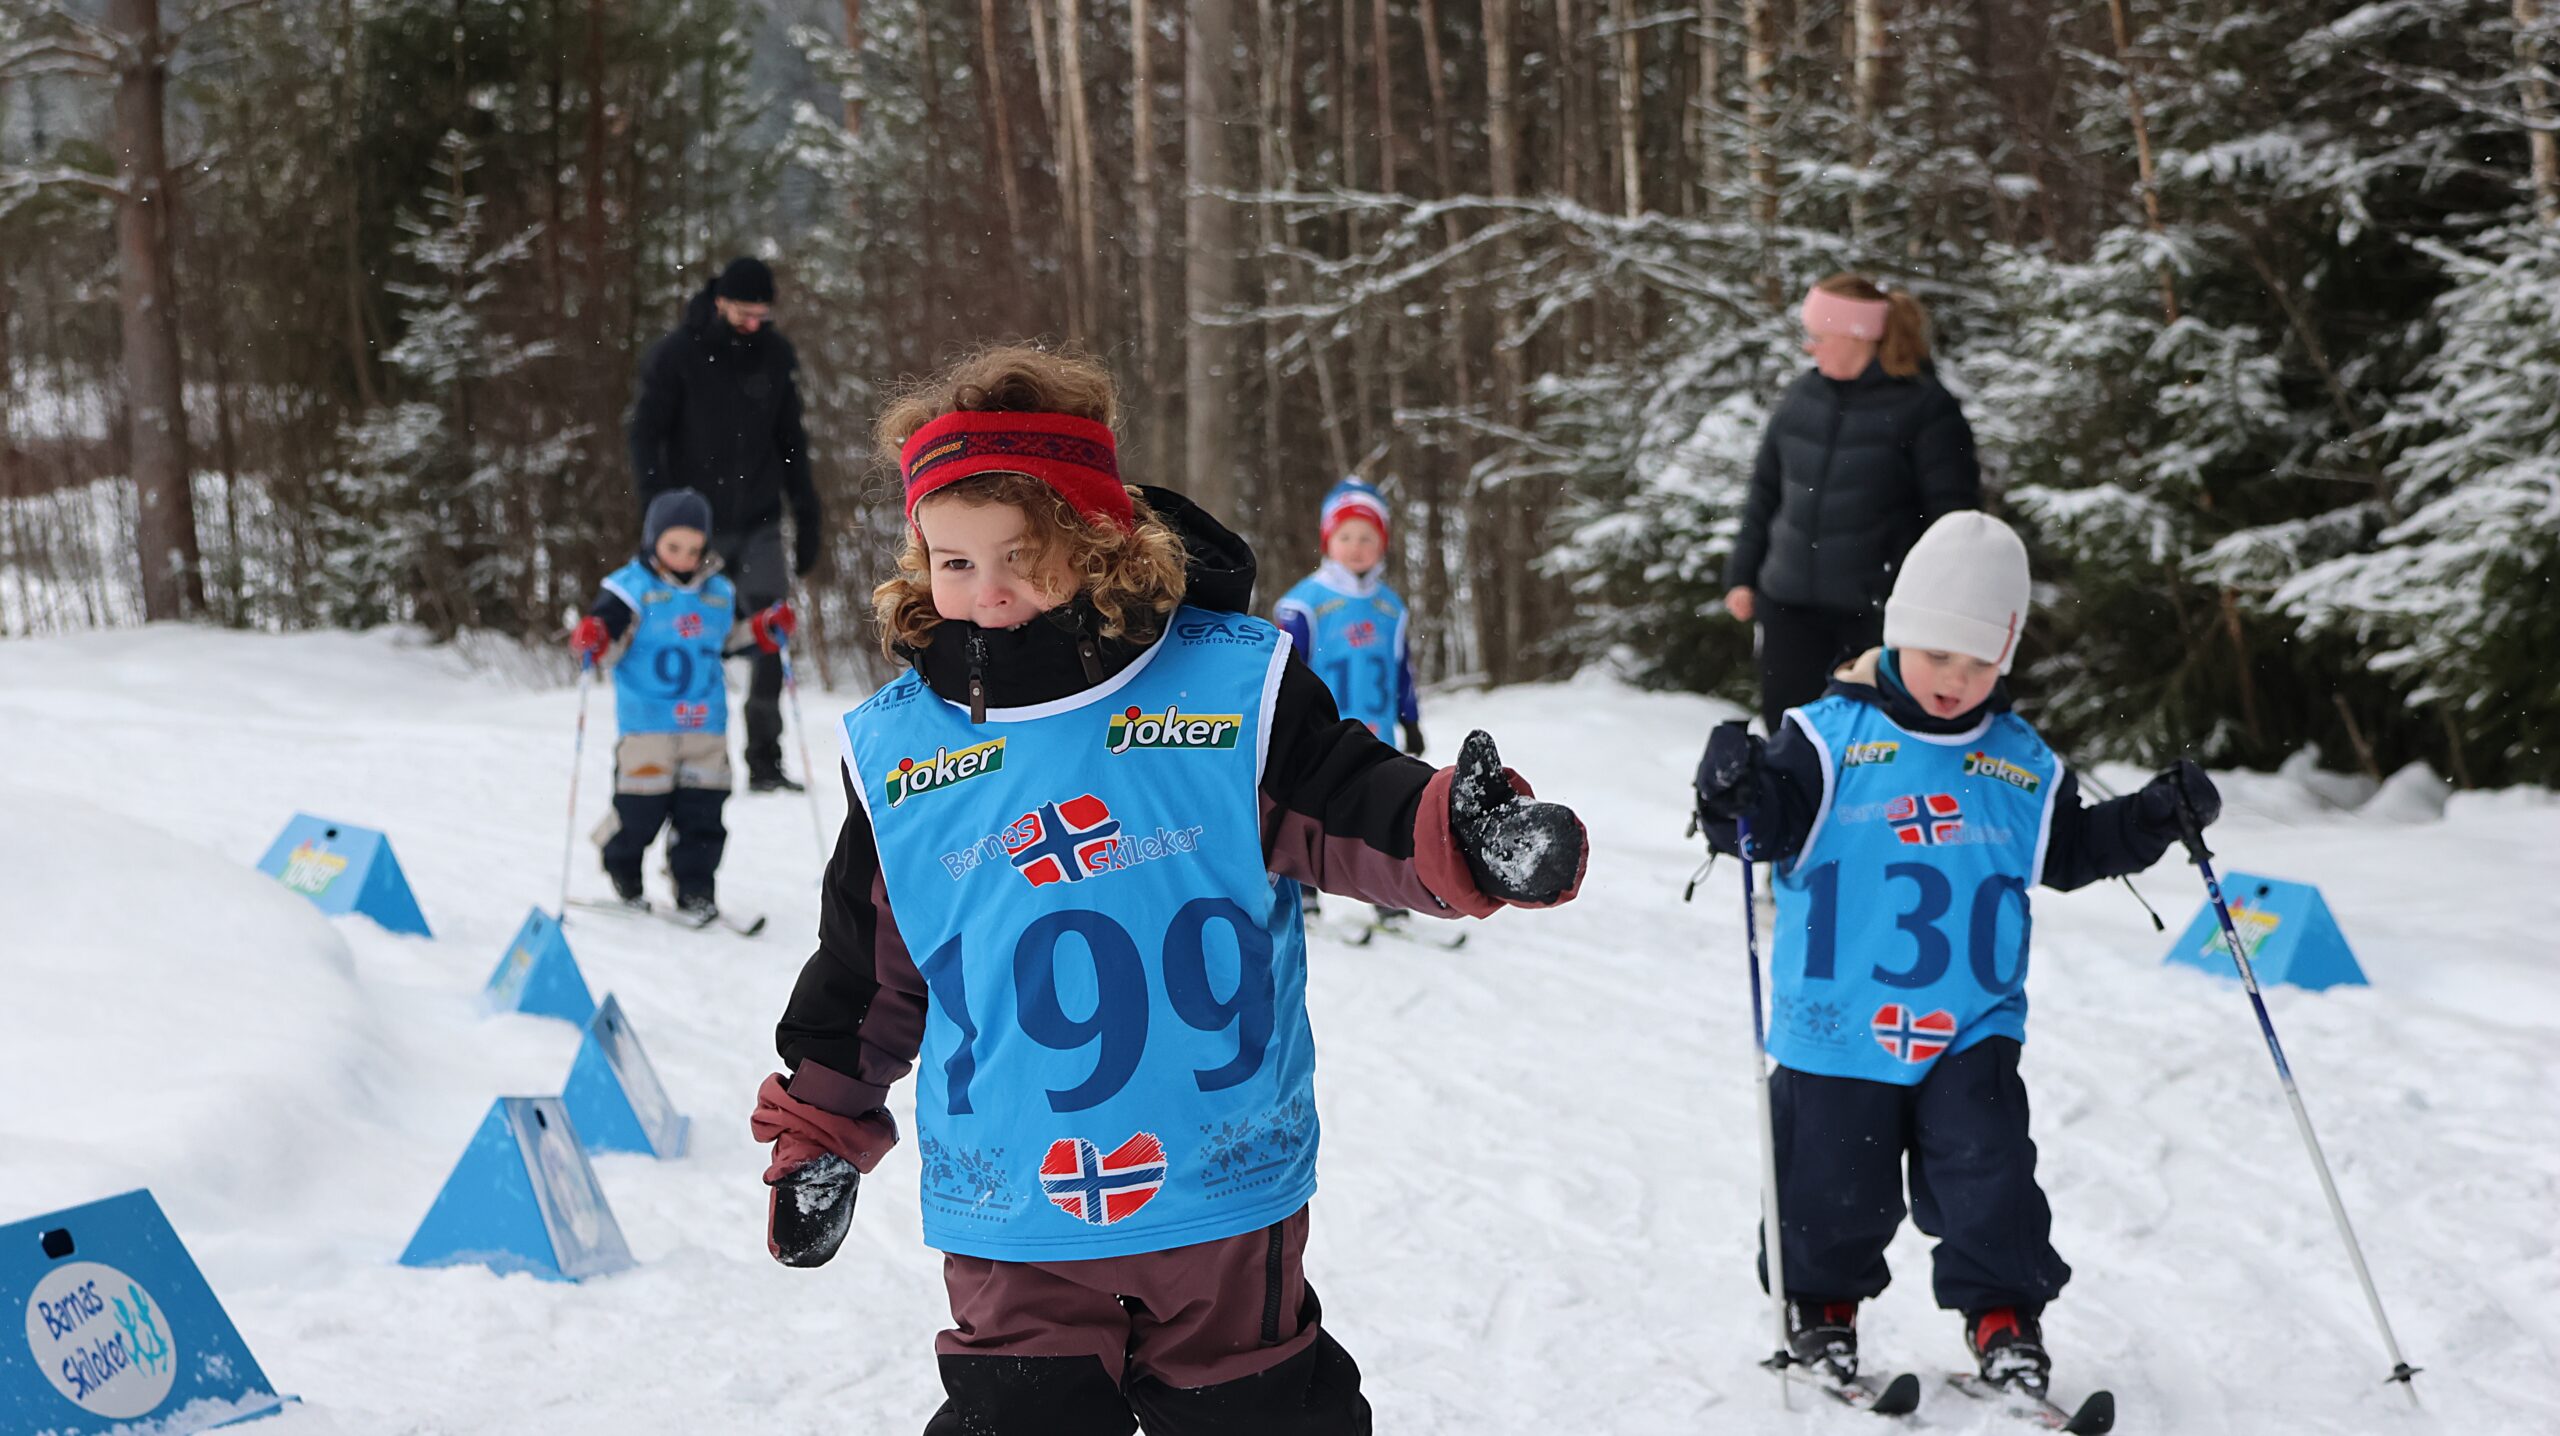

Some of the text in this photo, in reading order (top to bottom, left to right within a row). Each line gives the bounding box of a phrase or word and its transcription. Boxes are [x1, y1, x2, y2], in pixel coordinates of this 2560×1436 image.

[1182, 637, 1257, 647] SPORTSWEAR
[1110, 705, 1232, 754] joker
[891, 746, 998, 808] joker
[1965, 751, 2036, 789] joker
[939, 817, 1036, 880] Barnas
[1802, 859, 2032, 997] 130
[918, 897, 1276, 1116] 199
[38, 1279, 104, 1341] Barnas
[62, 1331, 130, 1401] Skileker
